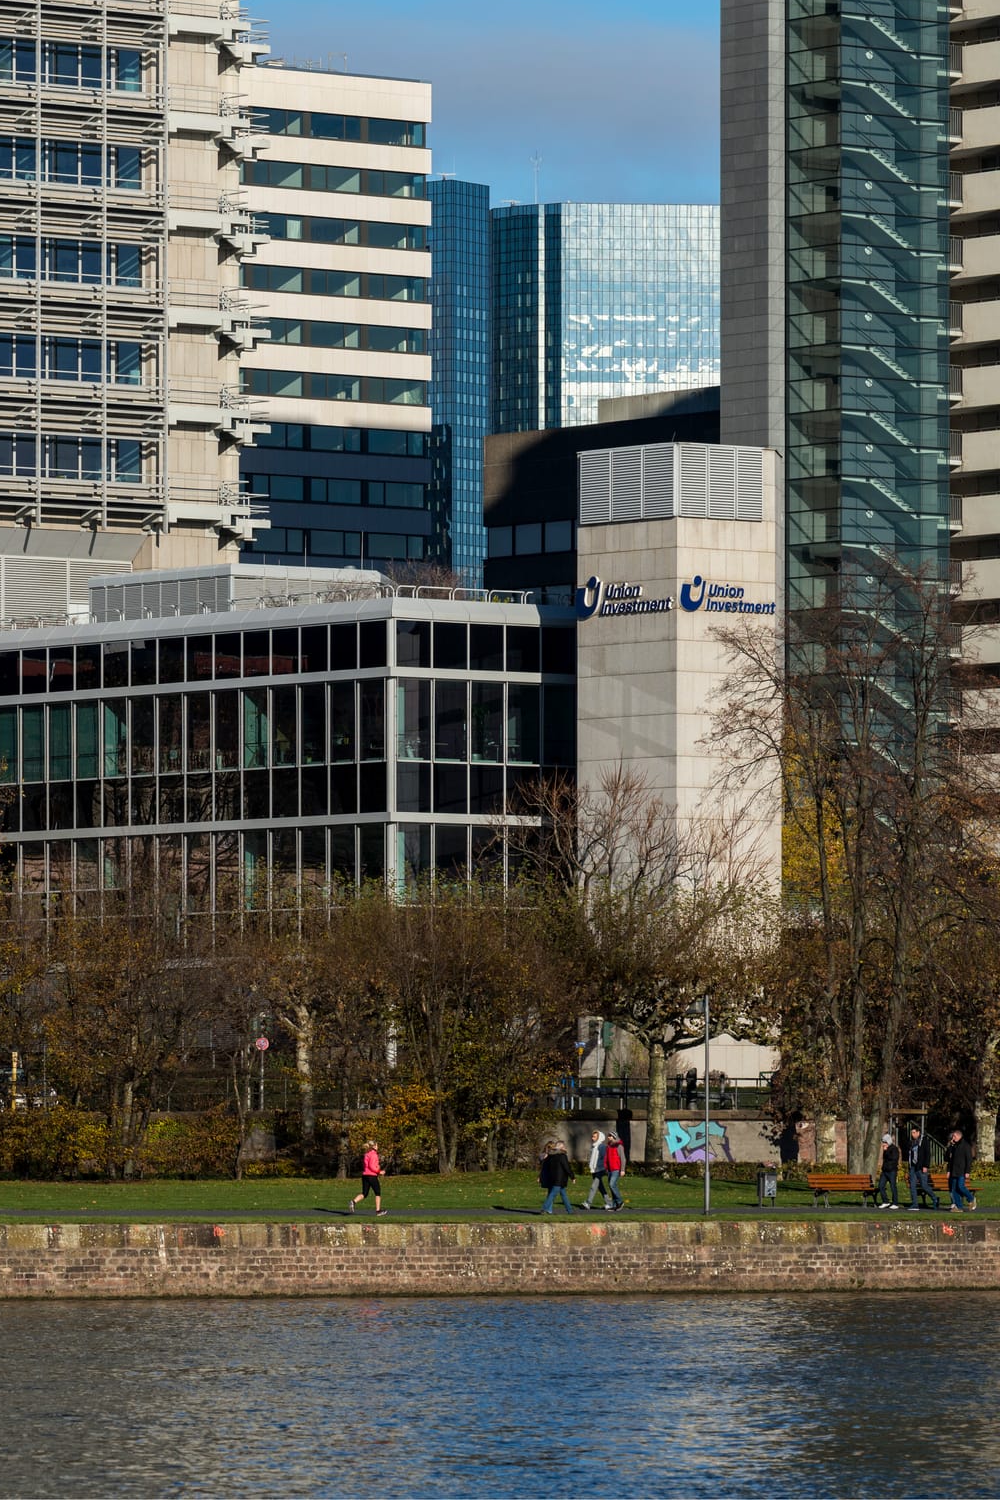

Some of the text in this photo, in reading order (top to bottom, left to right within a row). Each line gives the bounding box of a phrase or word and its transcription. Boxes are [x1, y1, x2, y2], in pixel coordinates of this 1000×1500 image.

[605, 582, 643, 599] Union
[708, 583, 744, 598] Union
[601, 596, 674, 617] Investment
[705, 598, 776, 615] Investment
